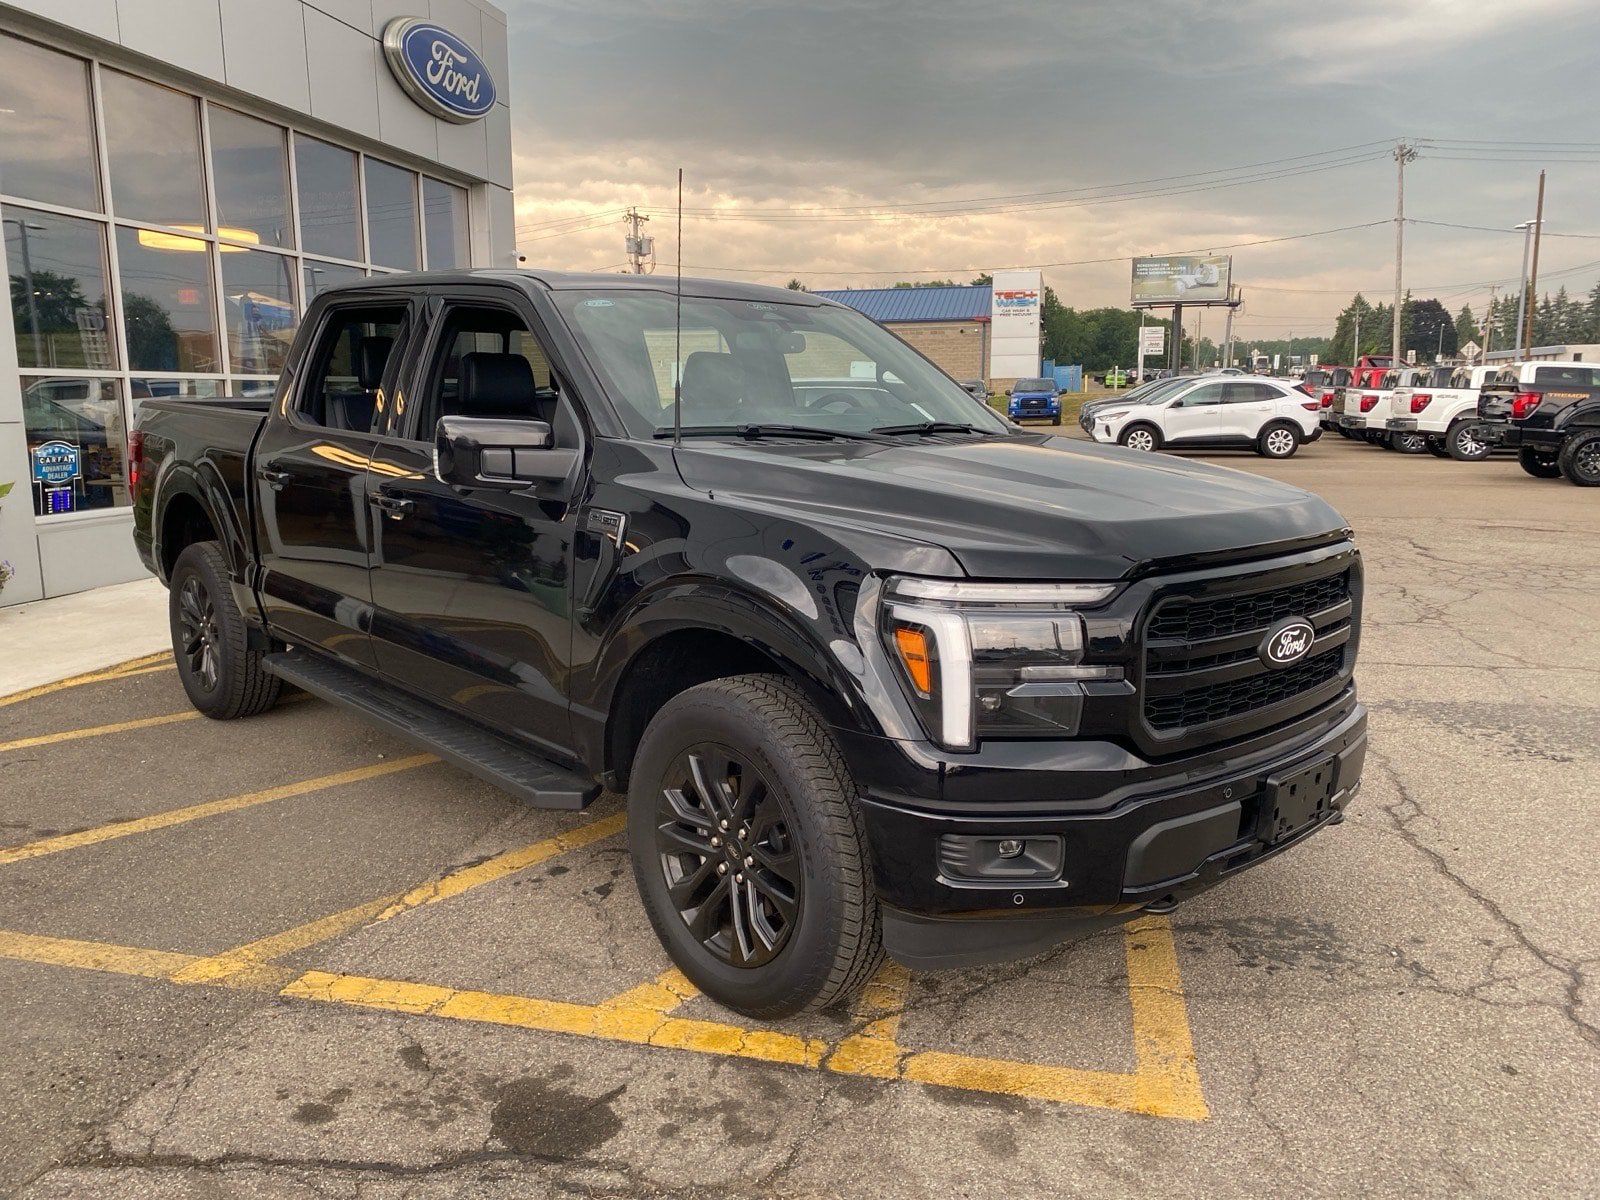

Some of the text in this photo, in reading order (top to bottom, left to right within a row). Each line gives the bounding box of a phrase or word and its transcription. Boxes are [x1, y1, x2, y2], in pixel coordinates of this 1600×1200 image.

[426, 40, 481, 104] Ford
[995, 299, 1037, 307] WASH
[1547, 392, 1591, 400] TREMOR
[39, 455, 75, 464] CARFAX
[42, 464, 73, 473] ADVANTAGE
[47, 472, 68, 480] DEALER
[1277, 629, 1307, 658] Ford
